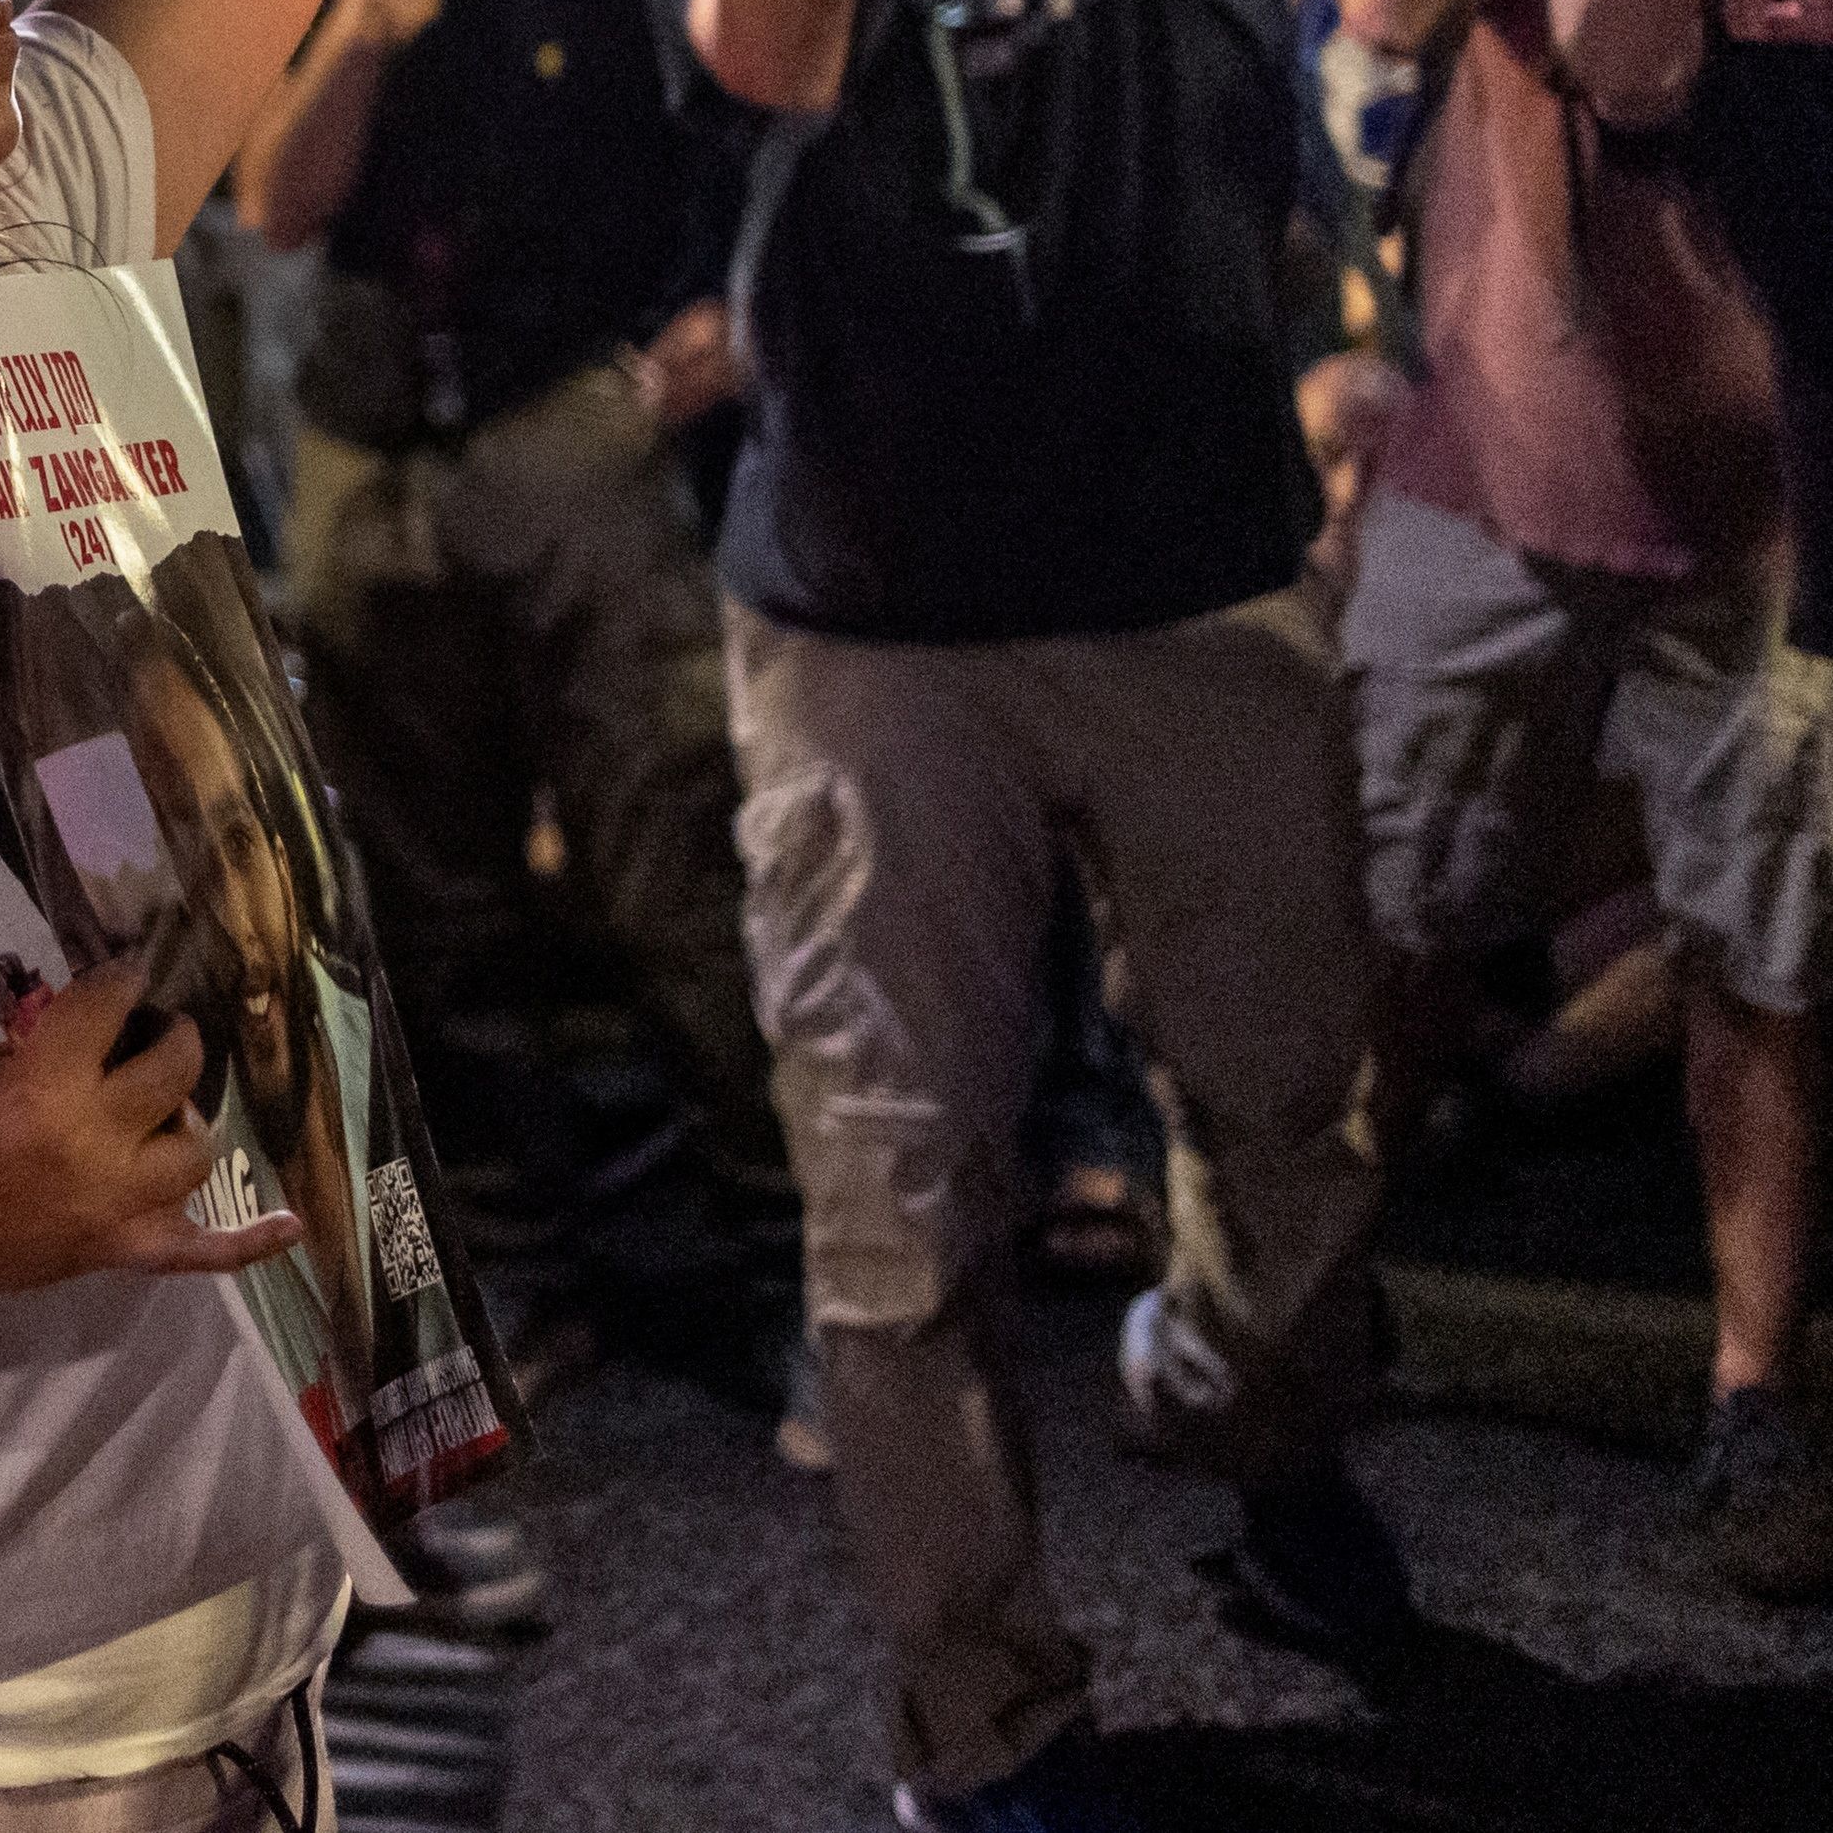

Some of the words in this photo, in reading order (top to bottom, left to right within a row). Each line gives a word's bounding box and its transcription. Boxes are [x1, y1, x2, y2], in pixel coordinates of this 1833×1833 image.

[41, 350, 102, 436] מתן
[28, 439, 190, 514] ZANGAKER
[60, 515, 117, 573] (24)
